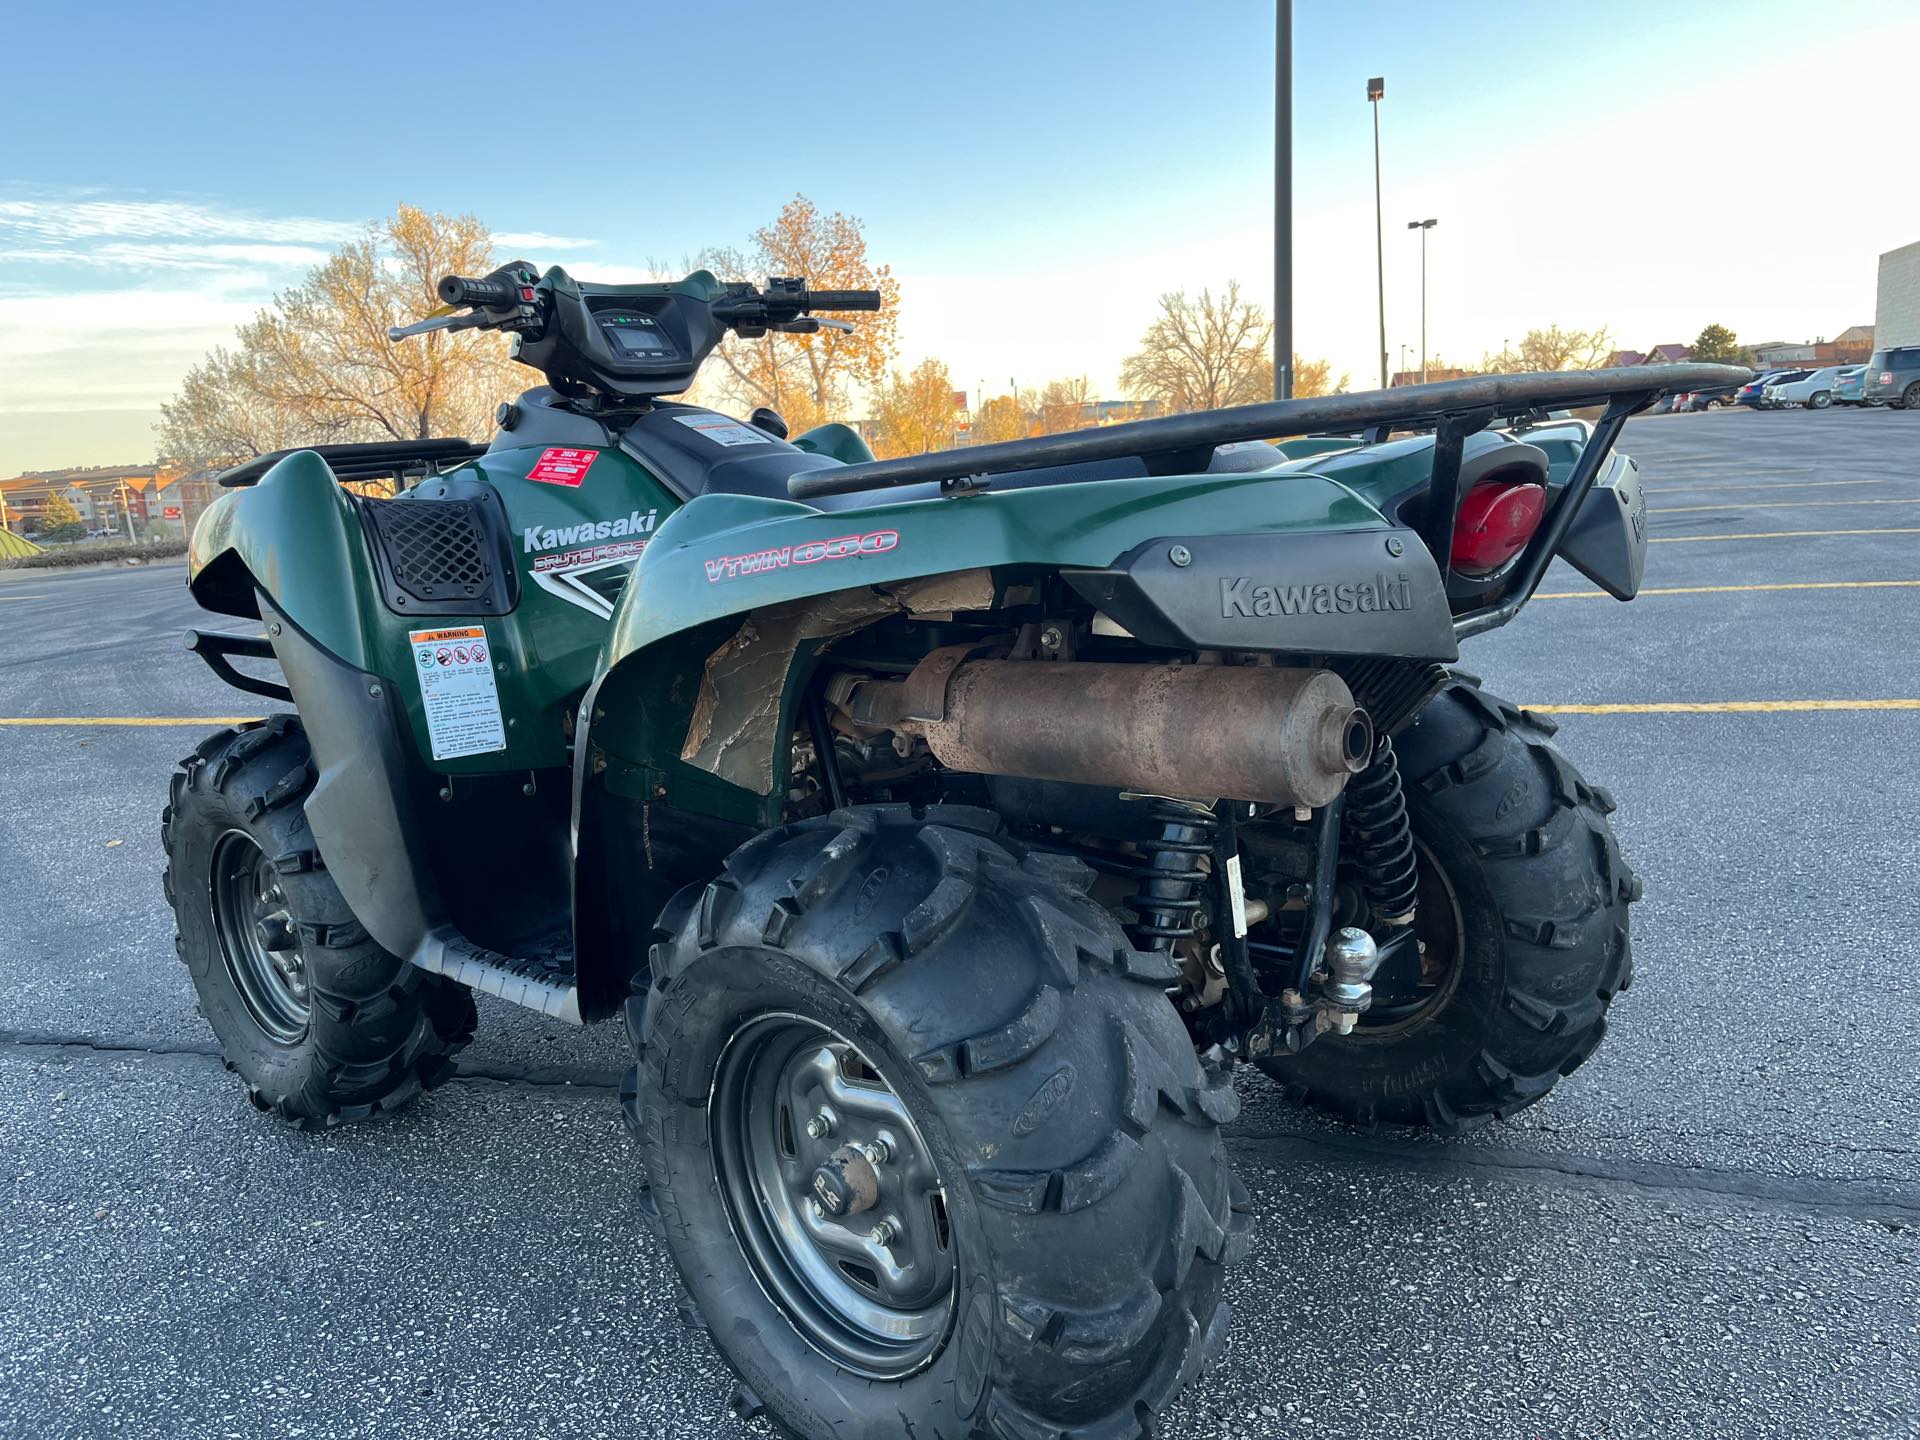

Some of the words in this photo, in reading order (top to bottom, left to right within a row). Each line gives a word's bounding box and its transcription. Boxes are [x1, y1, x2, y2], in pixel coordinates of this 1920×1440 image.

[524, 508, 658, 553] Kawasaki
[792, 528, 900, 564] 650
[1219, 573, 1413, 618] Kawasaki
[436, 630, 470, 640] WARNING
